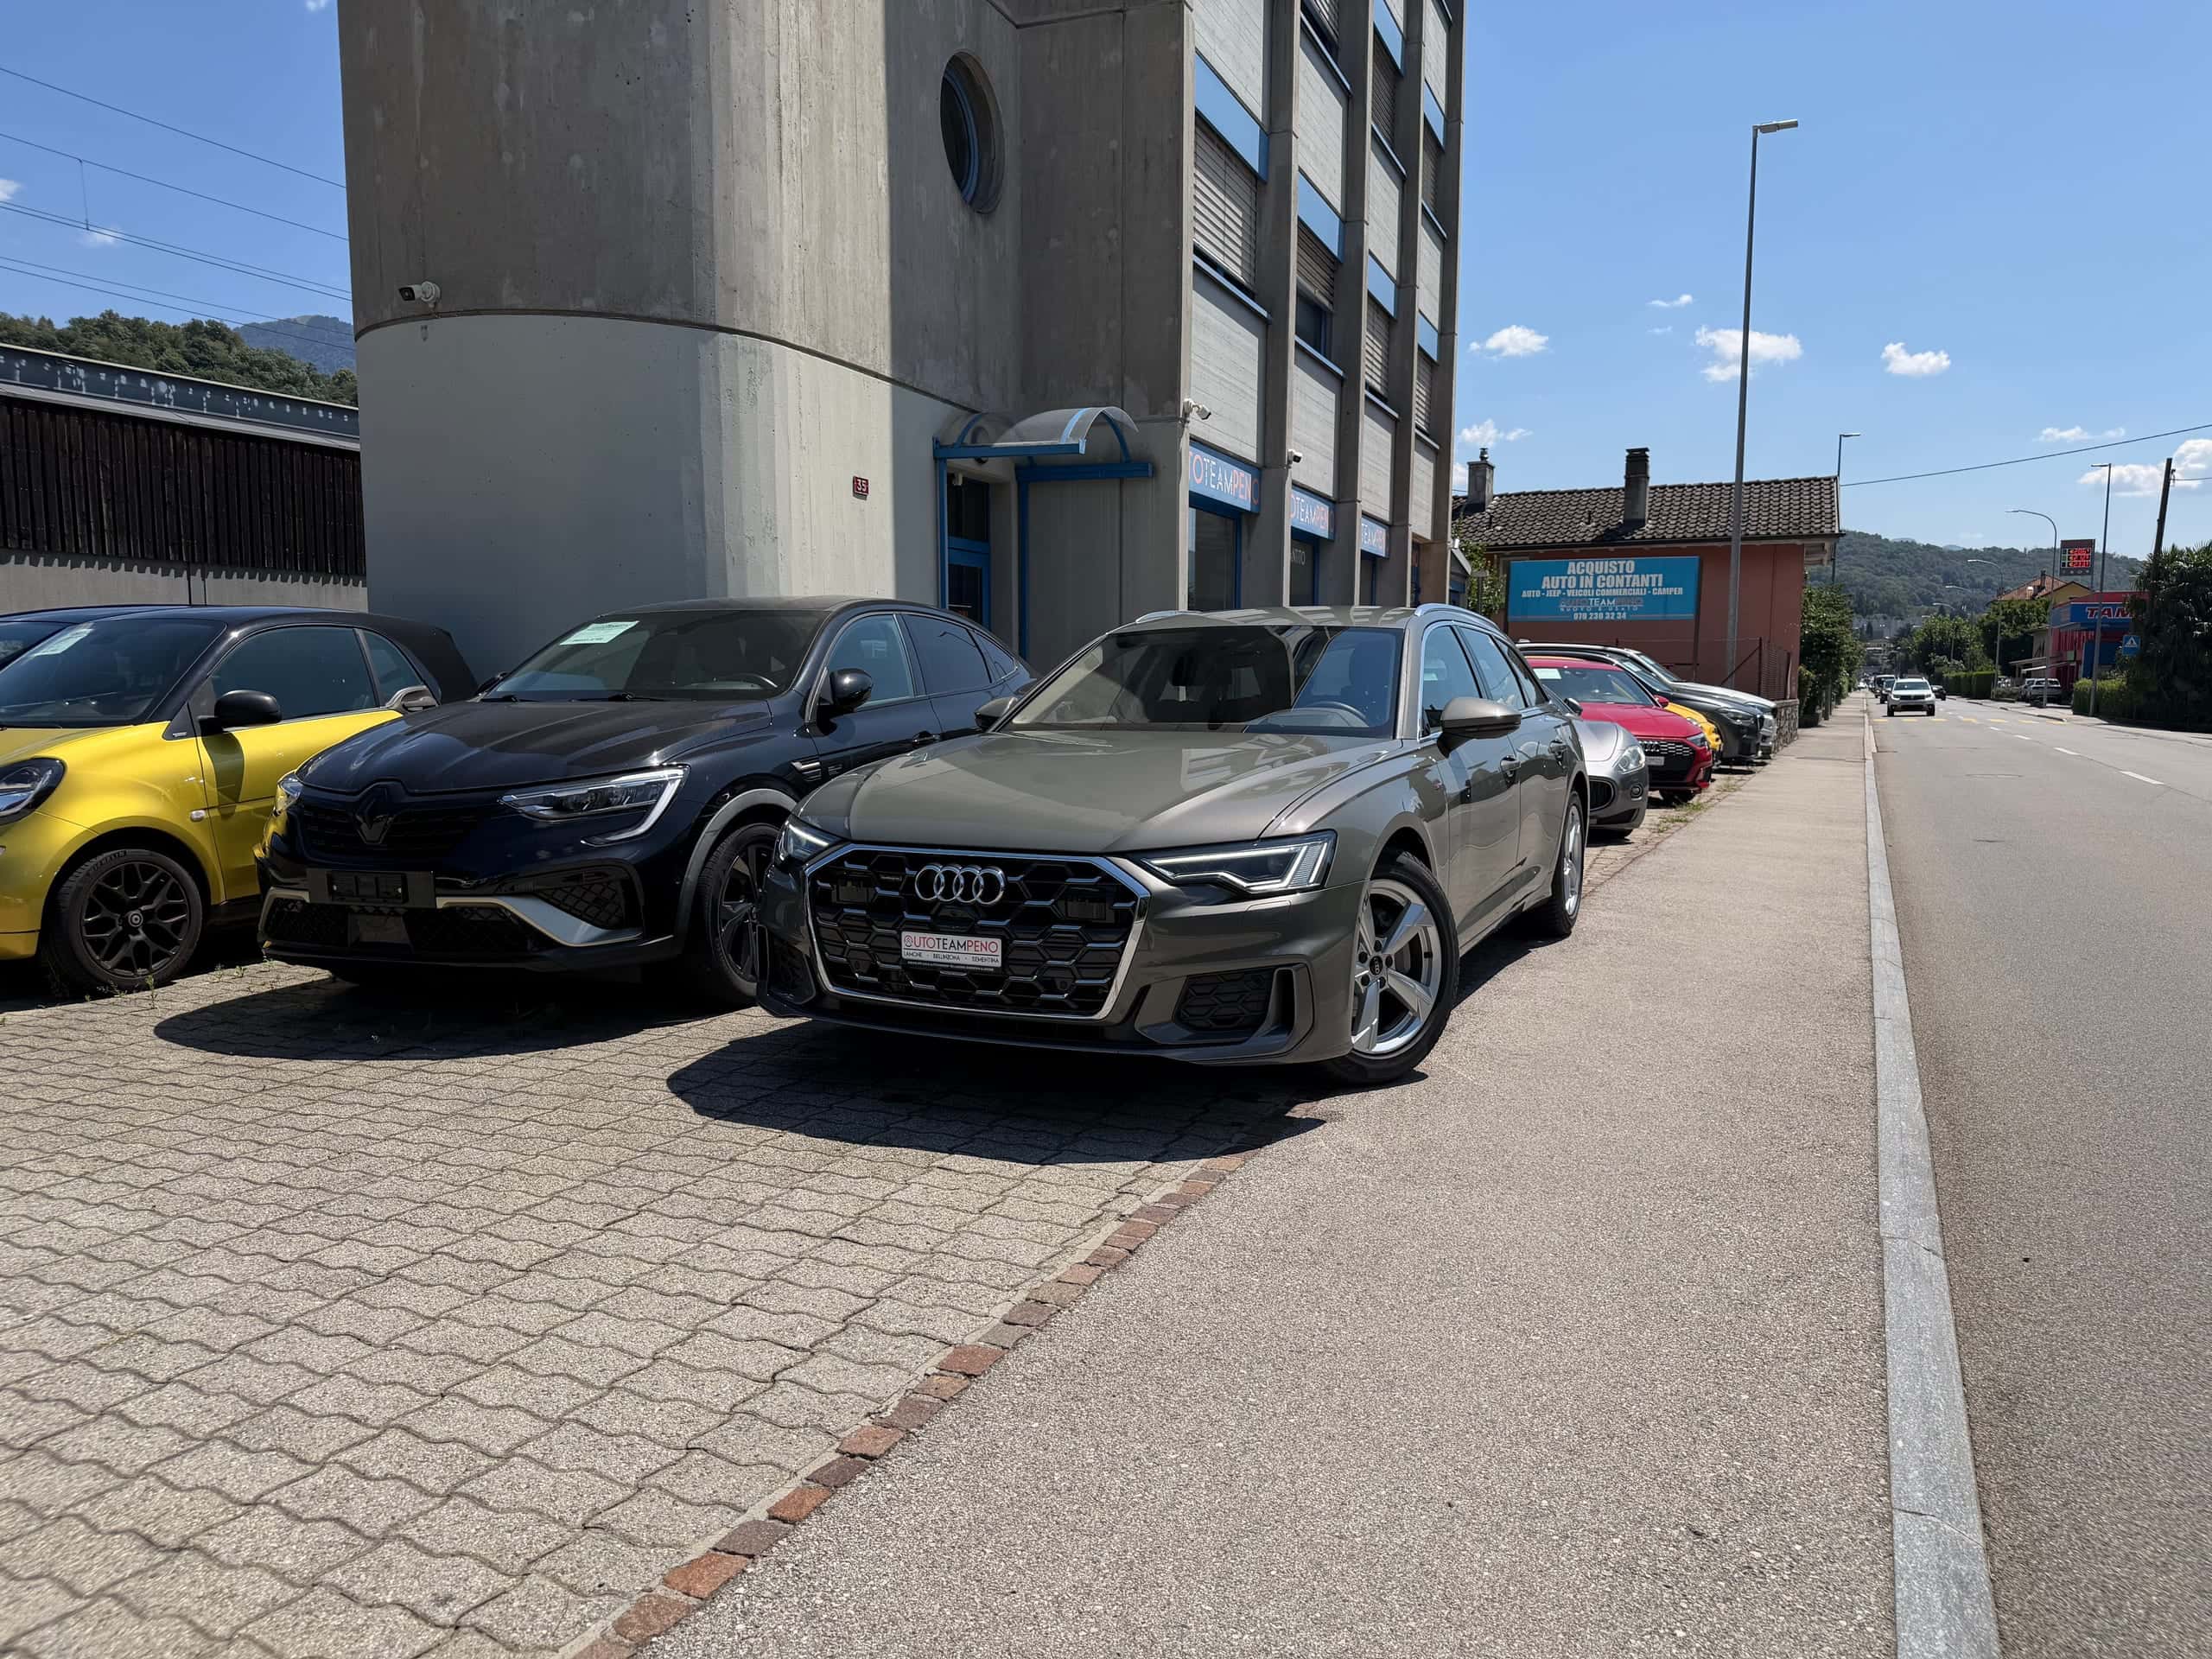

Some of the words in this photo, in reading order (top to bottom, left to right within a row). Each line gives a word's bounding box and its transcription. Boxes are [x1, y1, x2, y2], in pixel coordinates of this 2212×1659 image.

[856, 479, 868, 492] 35
[1567, 560, 1635, 575] ACQUISTO
[1541, 575, 1576, 589] AUTO
[1580, 575, 1593, 588] IN
[1597, 574, 1663, 588] CONTANTI
[1522, 589, 1541, 598] AUTO
[1567, 588, 1594, 597] VEICOLI
[1596, 588, 1646, 596] COMMERCIALI
[1652, 587, 1683, 595] CAMPER
